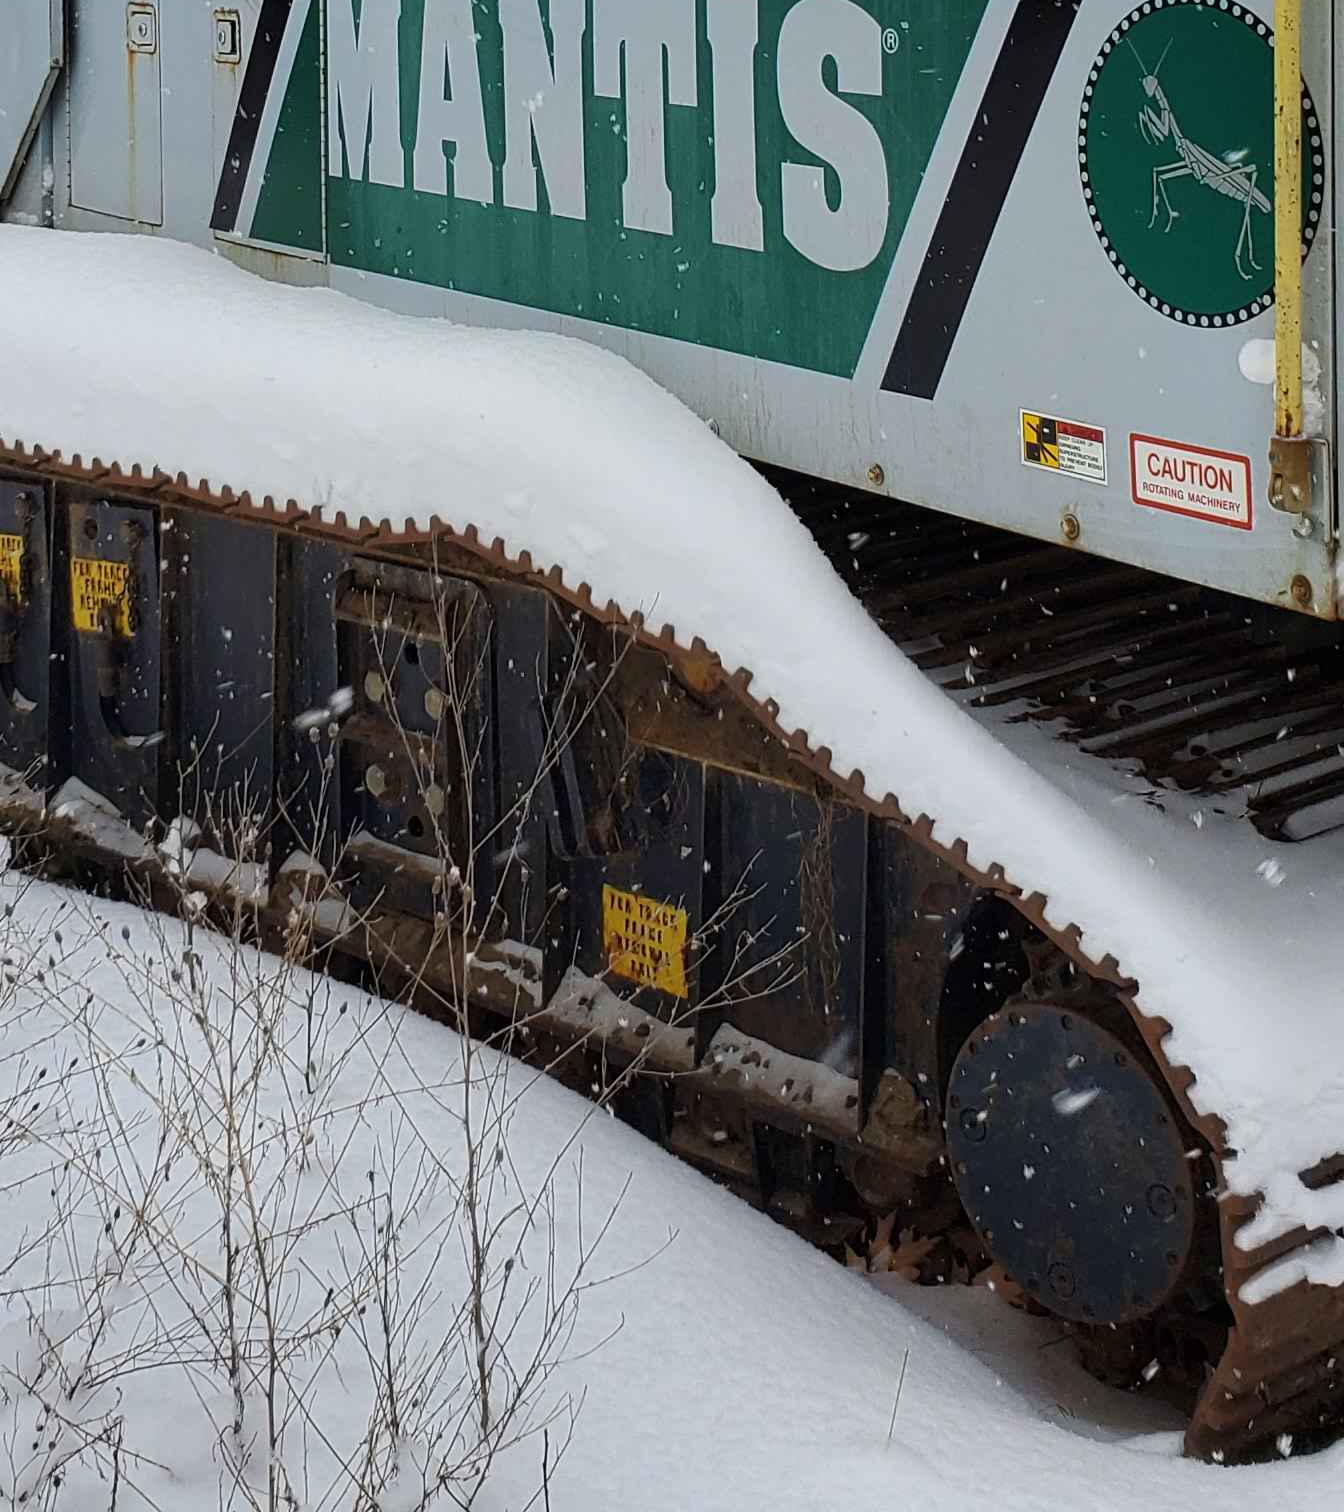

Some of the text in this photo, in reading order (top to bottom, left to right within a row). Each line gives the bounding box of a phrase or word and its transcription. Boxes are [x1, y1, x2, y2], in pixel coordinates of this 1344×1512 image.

[1147, 453, 1233, 494] CAUTION
[1142, 481, 1241, 513] ROTATING MACHINERY
